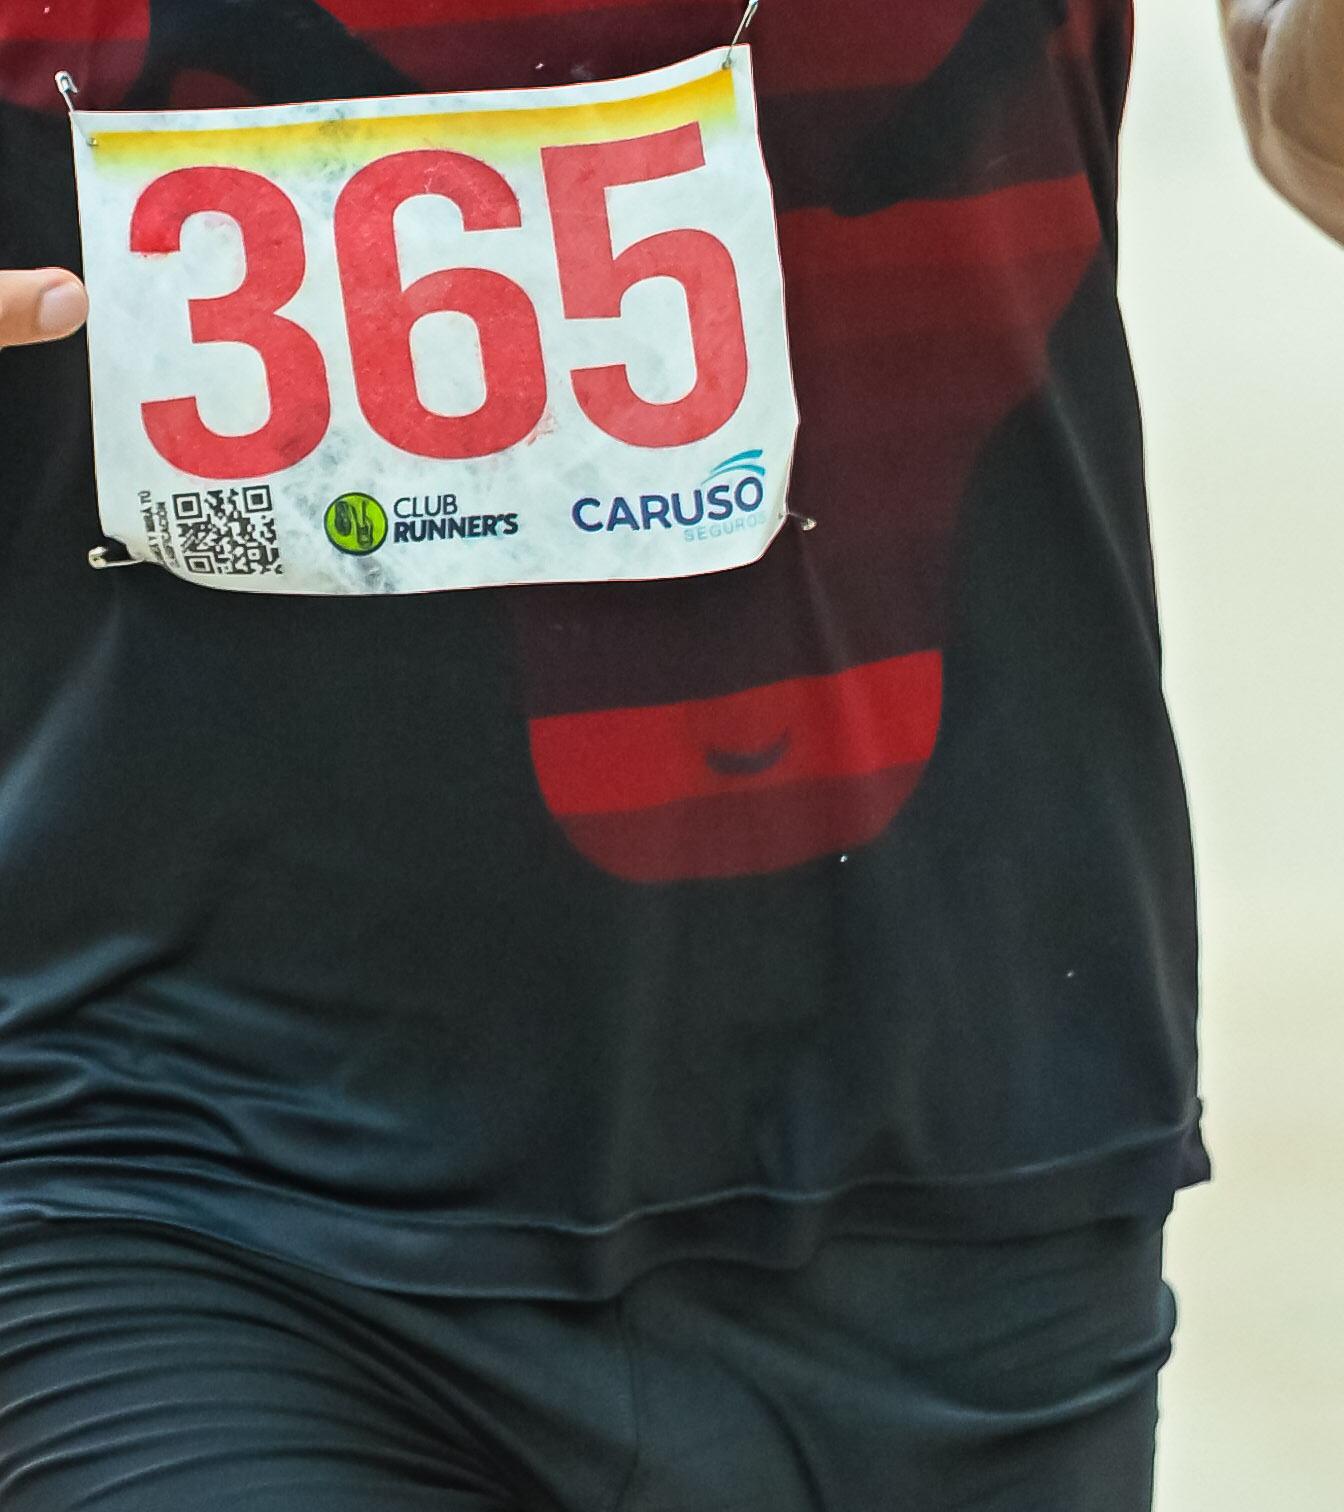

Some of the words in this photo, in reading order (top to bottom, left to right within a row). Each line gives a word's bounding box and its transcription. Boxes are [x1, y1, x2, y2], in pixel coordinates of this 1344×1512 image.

[129, 122, 749, 481] 365
[393, 493, 457, 519] CLUB
[571, 476, 764, 532] CARUSO
[393, 513, 518, 544] RUNNER'S
[683, 511, 767, 543] SEGUROS
